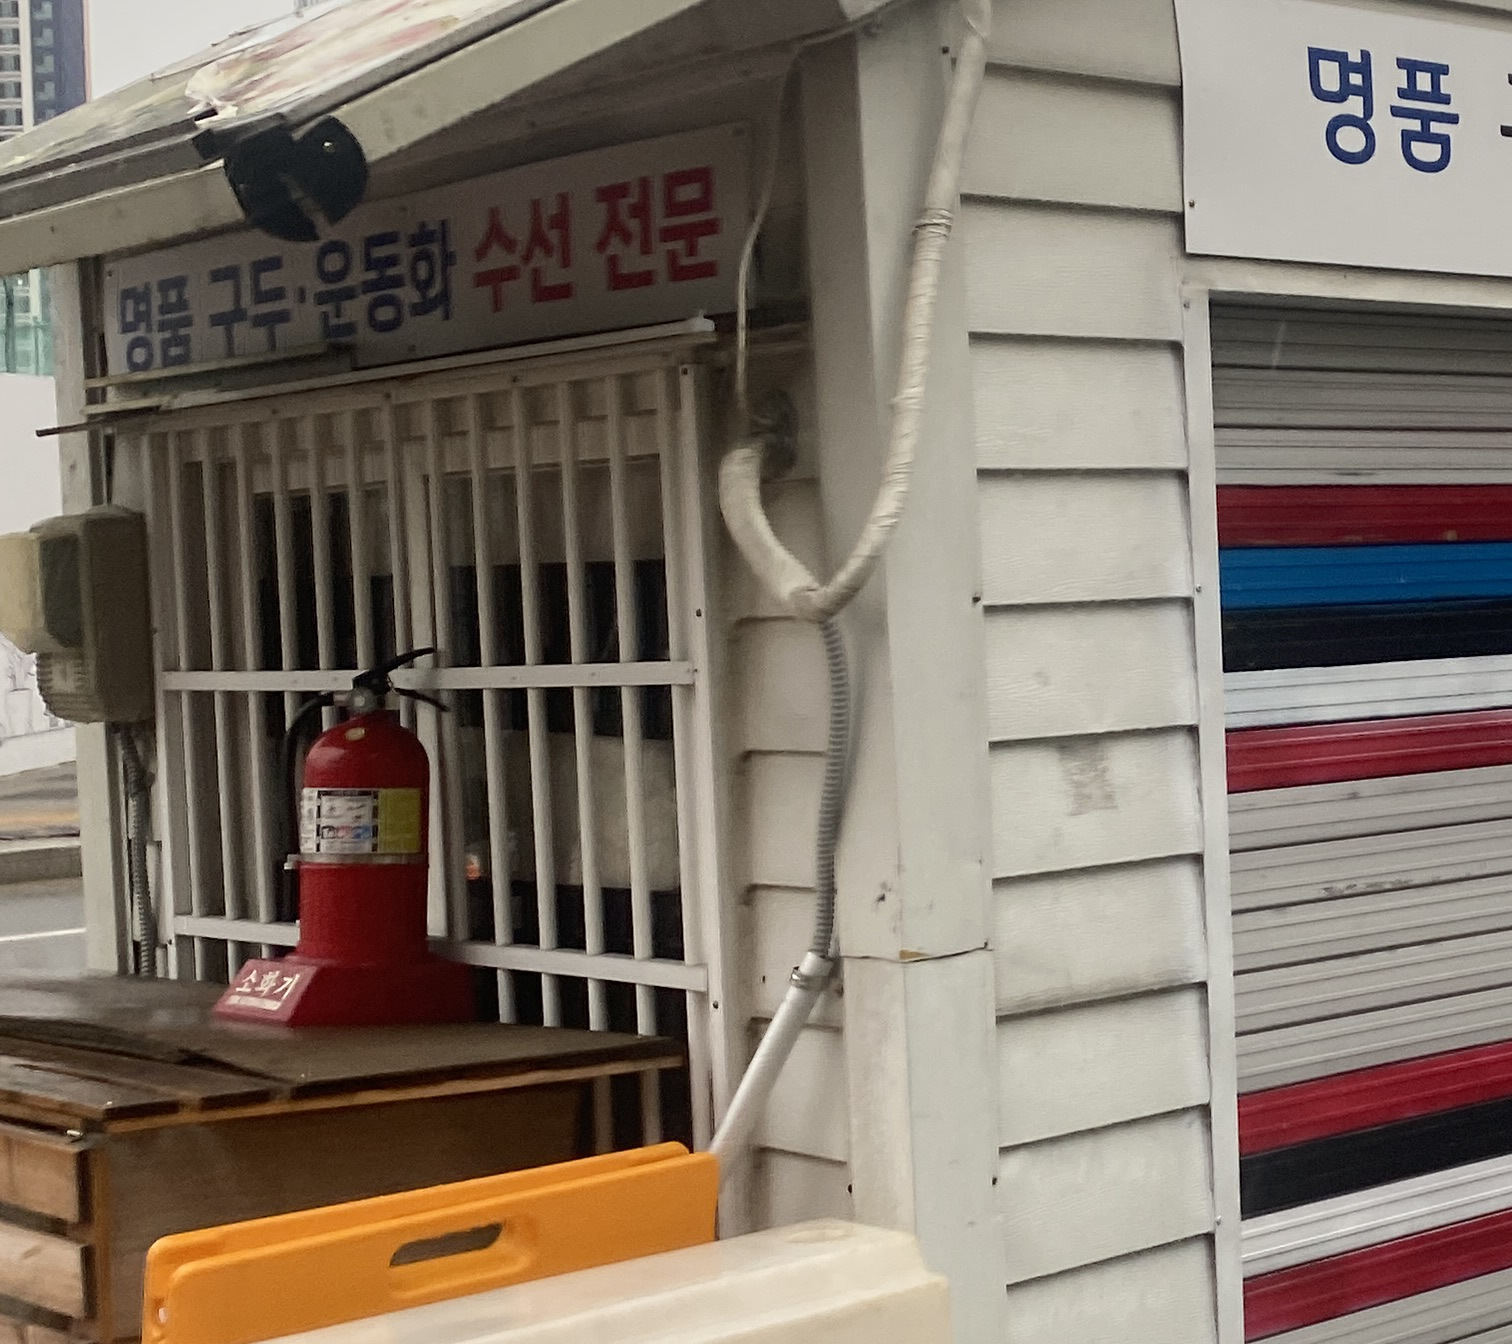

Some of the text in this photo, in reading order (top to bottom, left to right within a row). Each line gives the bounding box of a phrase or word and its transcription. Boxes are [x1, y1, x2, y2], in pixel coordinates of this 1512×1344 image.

[1307, 46, 1459, 174] 명품
[119, 281, 194, 373] 명품
[471, 192, 575, 314] 수선
[596, 164, 724, 293] 전문
[235, 969, 300, 1002] 소화기
